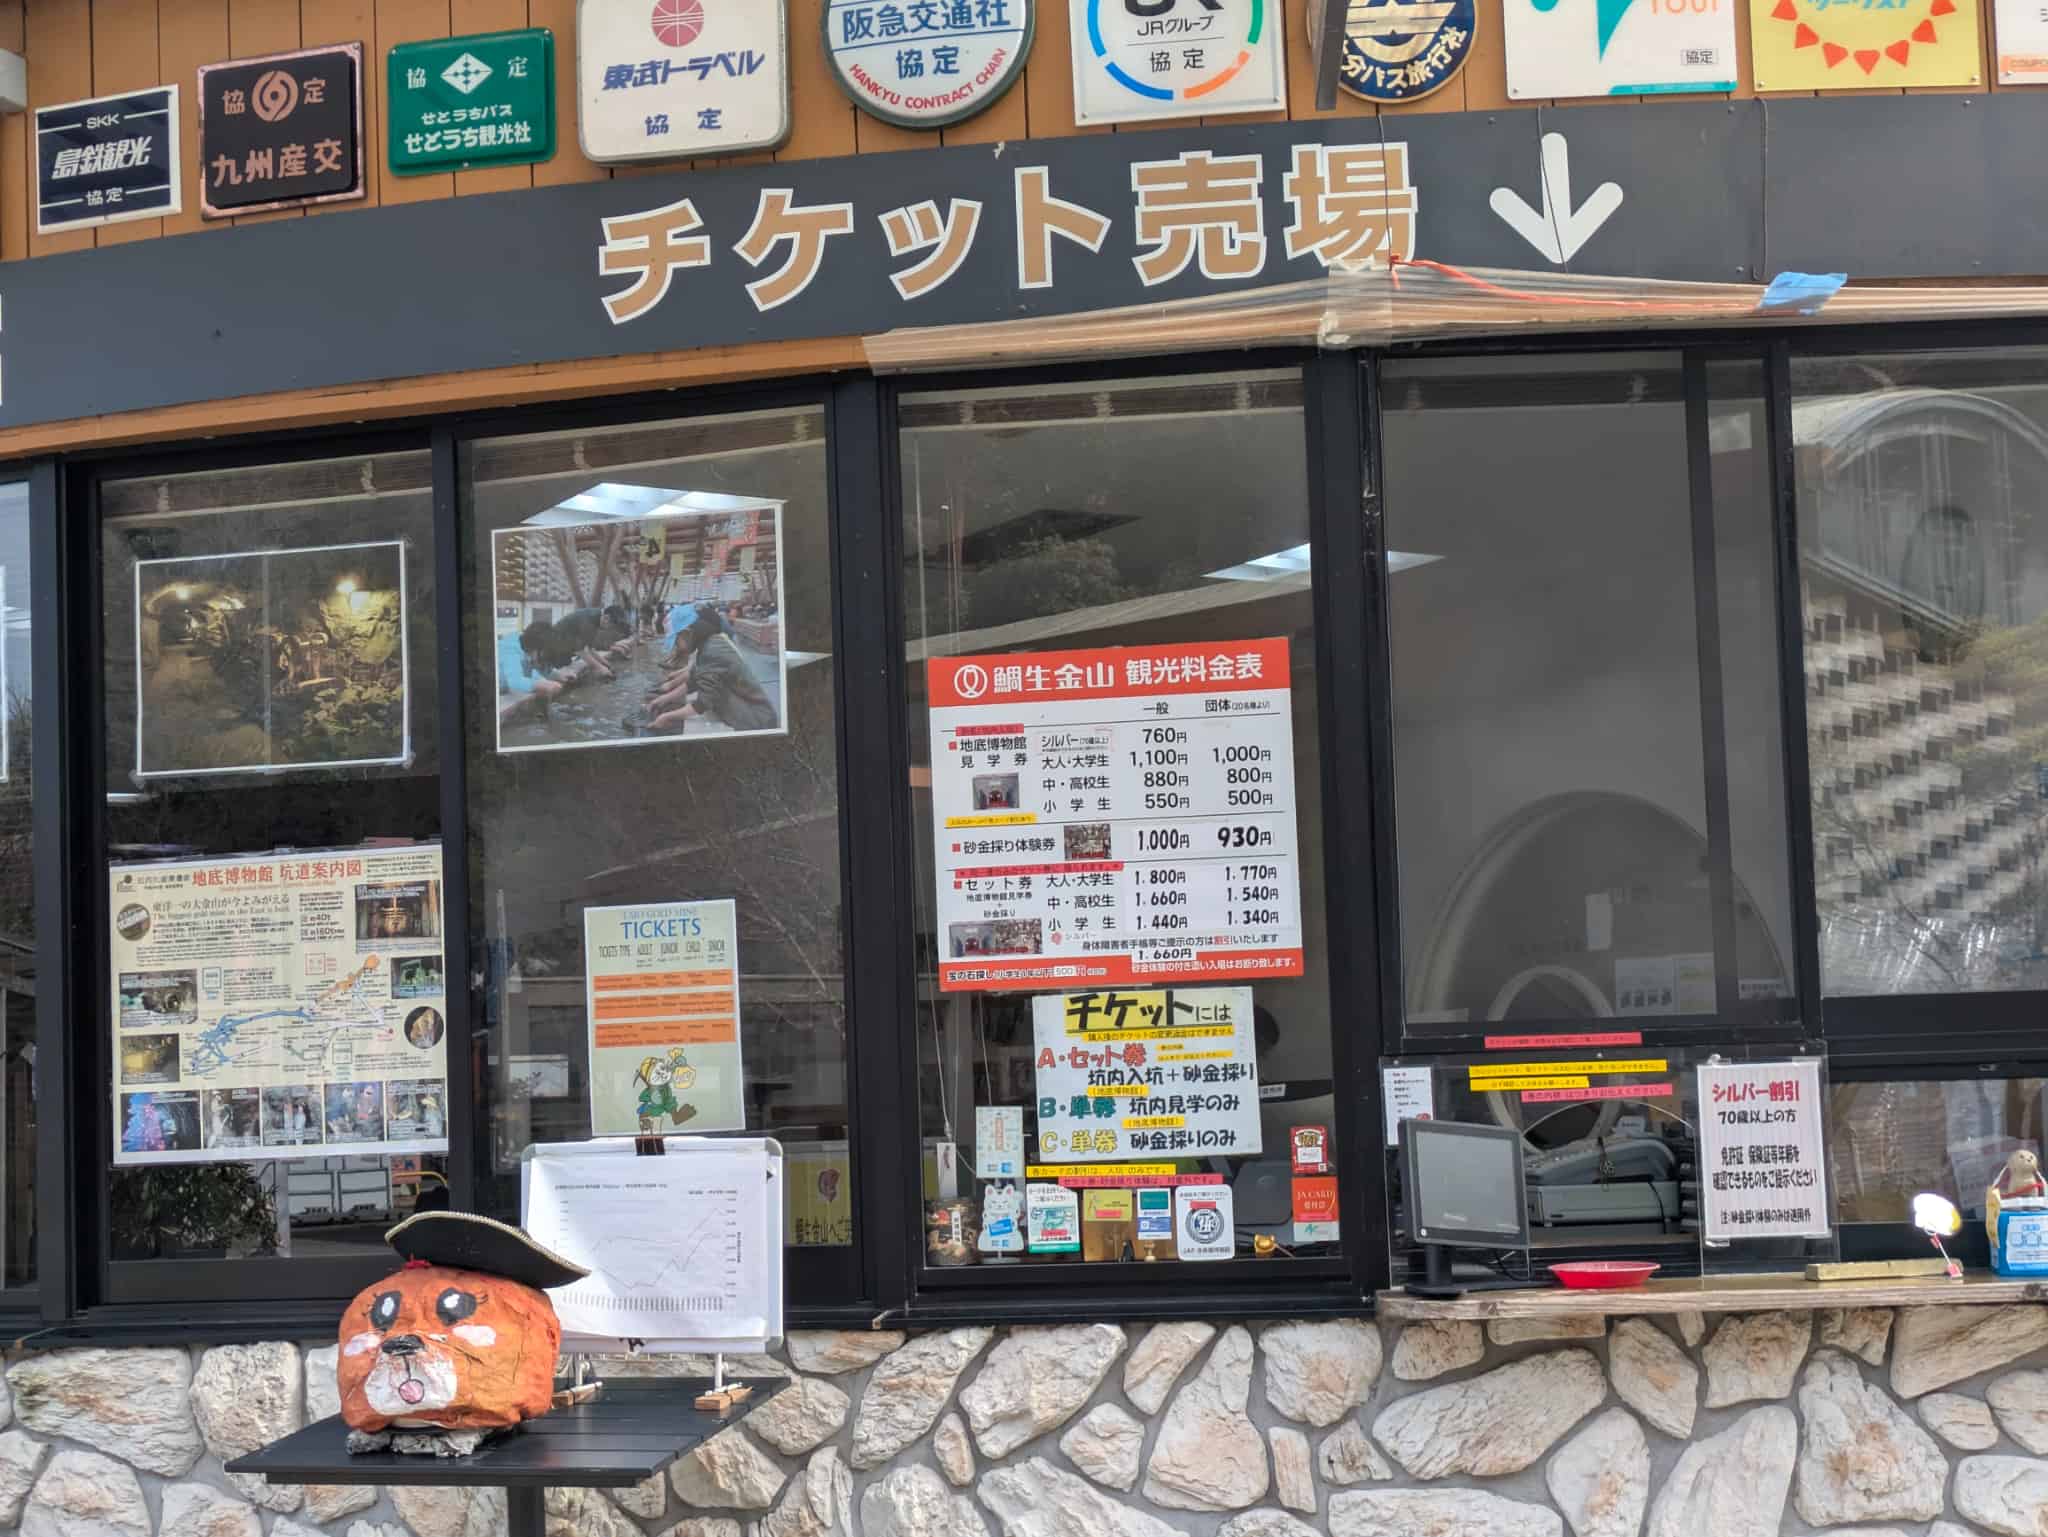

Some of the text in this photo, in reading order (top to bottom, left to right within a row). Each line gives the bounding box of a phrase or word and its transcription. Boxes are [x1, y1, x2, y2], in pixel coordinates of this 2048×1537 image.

[842, 0, 1011, 44] 阪急交通社
[1136, 15, 1215, 37] JRグループ
[895, 45, 961, 81] 協定
[1150, 48, 1206, 73] 協定
[1684, 49, 1714, 65] 協定
[406, 55, 529, 90] 協 定
[602, 48, 766, 91] 東武トラベル
[849, 47, 1008, 110] HANKYU CONTRACT CHAIN
[222, 76, 327, 116] 協 定
[86, 113, 120, 129] SKK
[421, 103, 513, 126] せとうちバス
[644, 107, 722, 137] 協定
[404, 120, 532, 154] せとうち観光社
[211, 138, 343, 188] 九州産交
[85, 187, 123, 206] 協定
[598, 140, 1419, 325] チケット売場
[992, 652, 1264, 694] 鯛生金山 観光料金表
[1143, 701, 1169, 715] 一般
[959, 736, 1028, 752] 地底博物館
[1141, 727, 1188, 744] 760円
[1041, 753, 1110, 770] 大人・大学生
[1129, 748, 1188, 768] 1,100円
[1212, 745, 1272, 765] 1,000円
[1143, 770, 1189, 788] 880円
[1226, 767, 1273, 784] 800円
[1144, 792, 1190, 809] 550円
[1227, 789, 1273, 806] 500円
[963, 837, 1056, 855] 砂金採り体験券
[1217, 826, 1273, 848] 930円
[191, 865, 274, 887] 地底博物館
[280, 859, 362, 881] 坑道案内図
[1046, 873, 1114, 889] 大人・大学生
[620, 918, 701, 940] TICKETS
[1066, 990, 1232, 1031] チケットには
[1711, 1080, 1800, 1102] シルバー割引
[1128, 1094, 1241, 1116] 坑内見学のみ
[1717, 1108, 1797, 1125] 70歳以上の方
[1130, 1129, 1237, 1150] 砂金採りのみ
